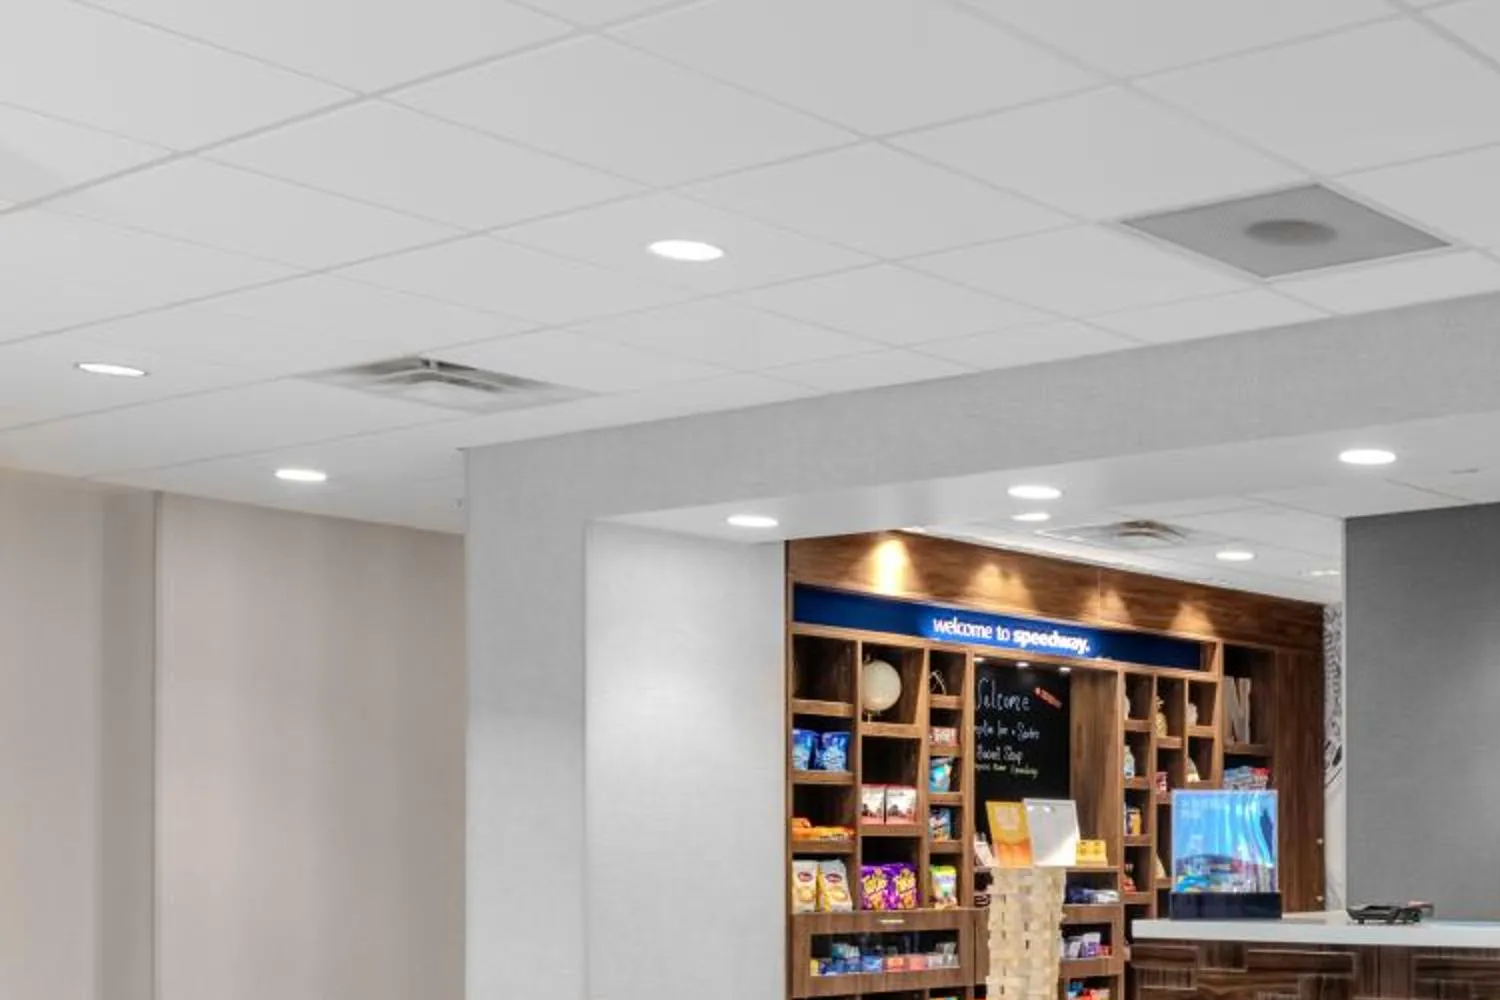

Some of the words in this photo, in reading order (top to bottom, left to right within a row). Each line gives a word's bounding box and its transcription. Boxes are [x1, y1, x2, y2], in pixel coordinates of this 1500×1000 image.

[932, 616, 993, 639] welcome
[996, 625, 1011, 642] to
[1013, 630, 1091, 655] speedway.
